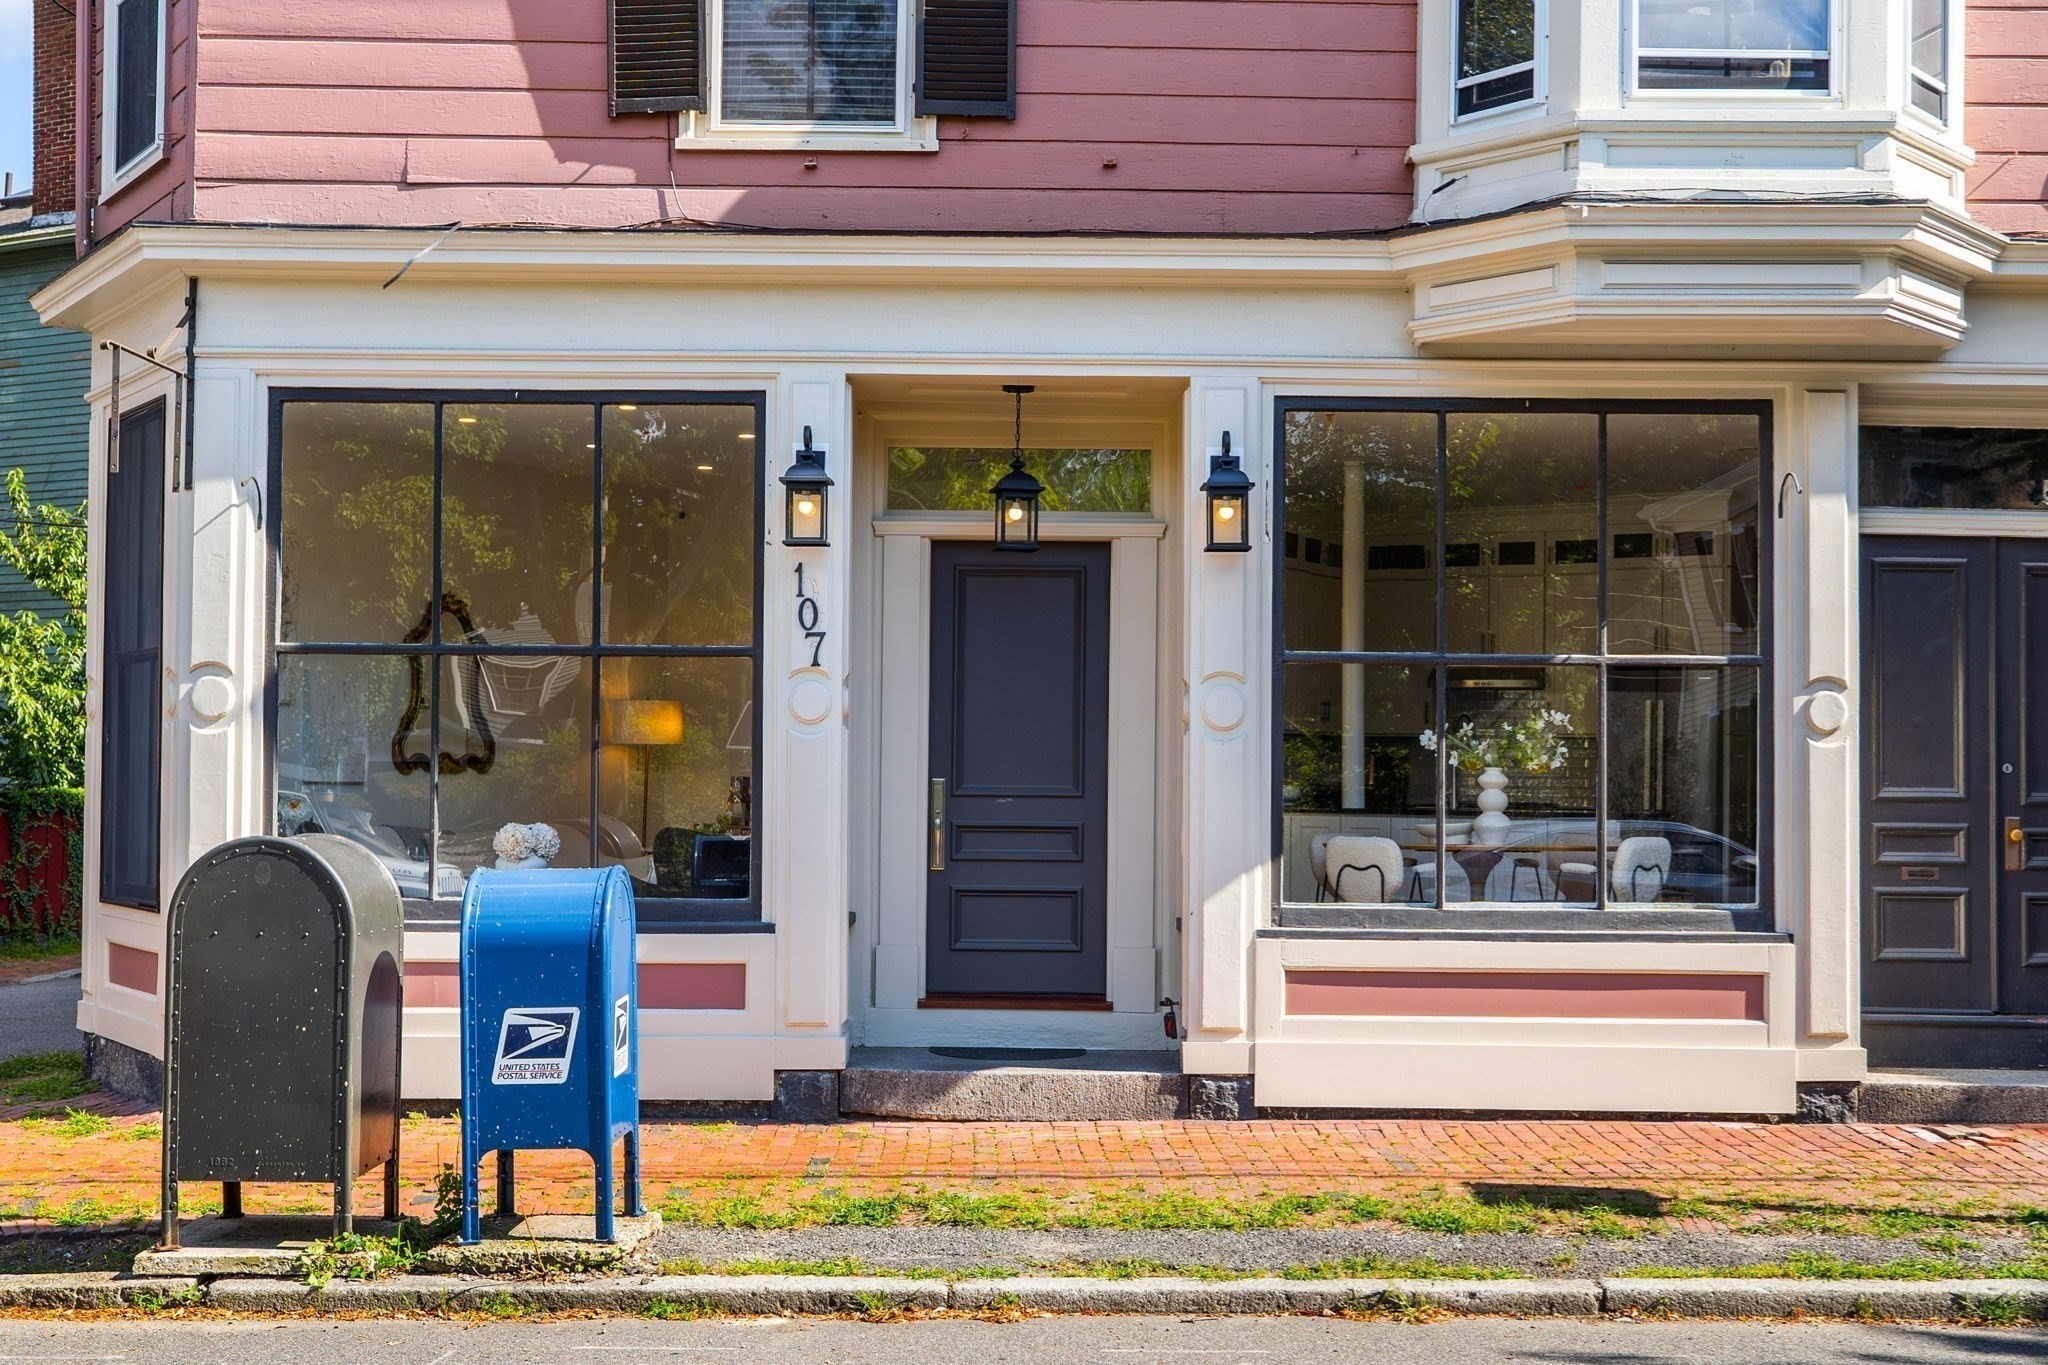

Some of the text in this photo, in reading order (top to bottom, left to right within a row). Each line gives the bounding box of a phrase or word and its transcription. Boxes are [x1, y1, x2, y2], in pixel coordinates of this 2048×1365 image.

[794, 562, 826, 667] 107
[499, 1062, 560, 1071] UNITED STATES
[497, 1071, 563, 1080] POSTAL SERVICE
